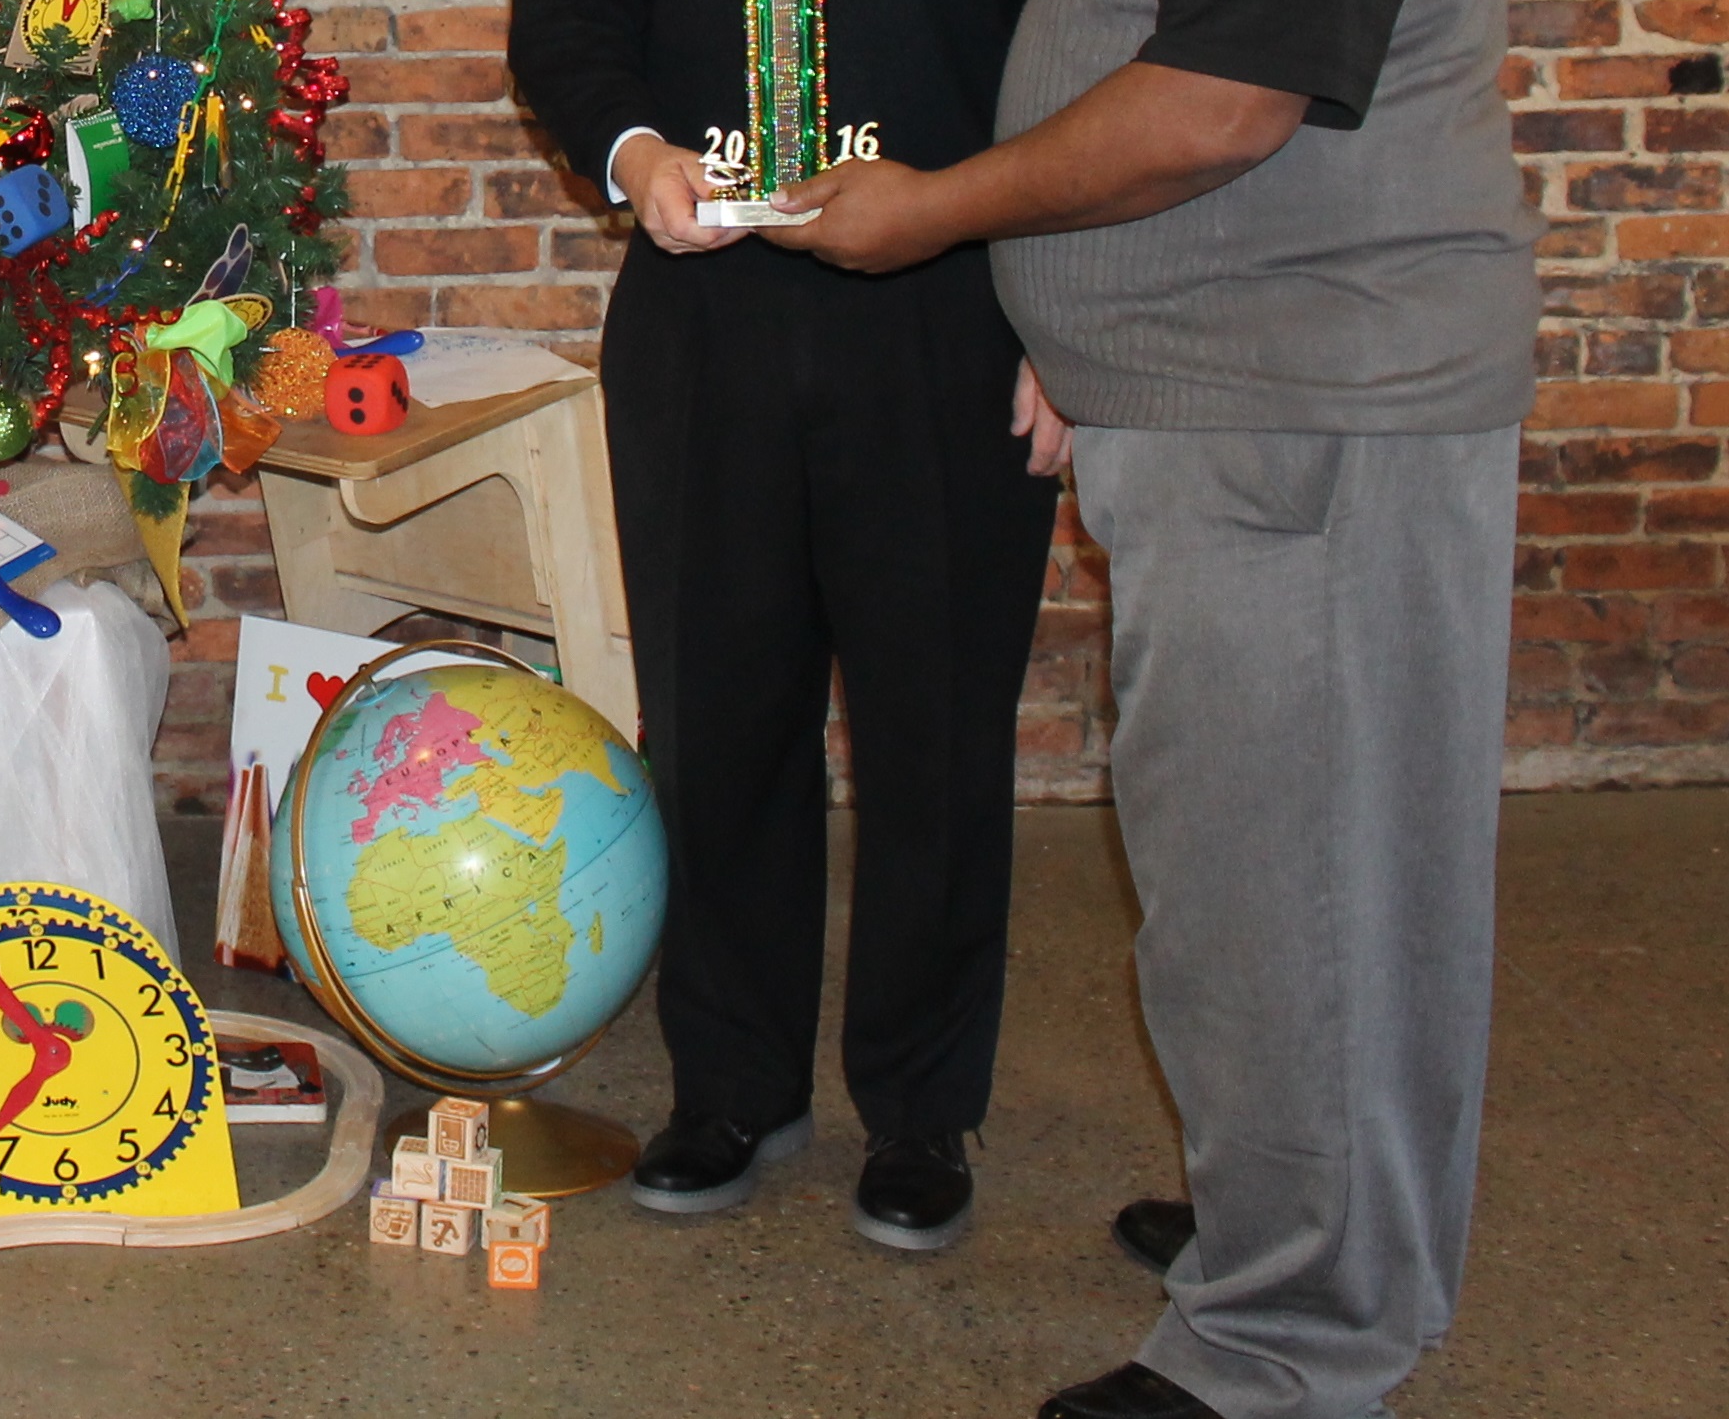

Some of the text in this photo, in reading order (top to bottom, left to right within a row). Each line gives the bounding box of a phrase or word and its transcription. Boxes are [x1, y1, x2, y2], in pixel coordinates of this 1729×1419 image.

[32, 8, 40, 20] 9
[90, 0, 99, 11] 2
[91, 16, 99, 27] 3
[698, 121, 881, 168] 20 16
[265, 664, 289, 703] I
[384, 729, 473, 786] EUROPE
[385, 851, 538, 934] AFRICA
[21, 938, 59, 971] 12
[89, 948, 106, 980] 1
[138, 983, 165, 1018] 2
[163, 1033, 190, 1067] 3
[41, 1095, 78, 1110] Judy
[151, 1087, 179, 1121] 4
[115, 1128, 141, 1164] 5
[53, 1147, 80, 1182] 6
